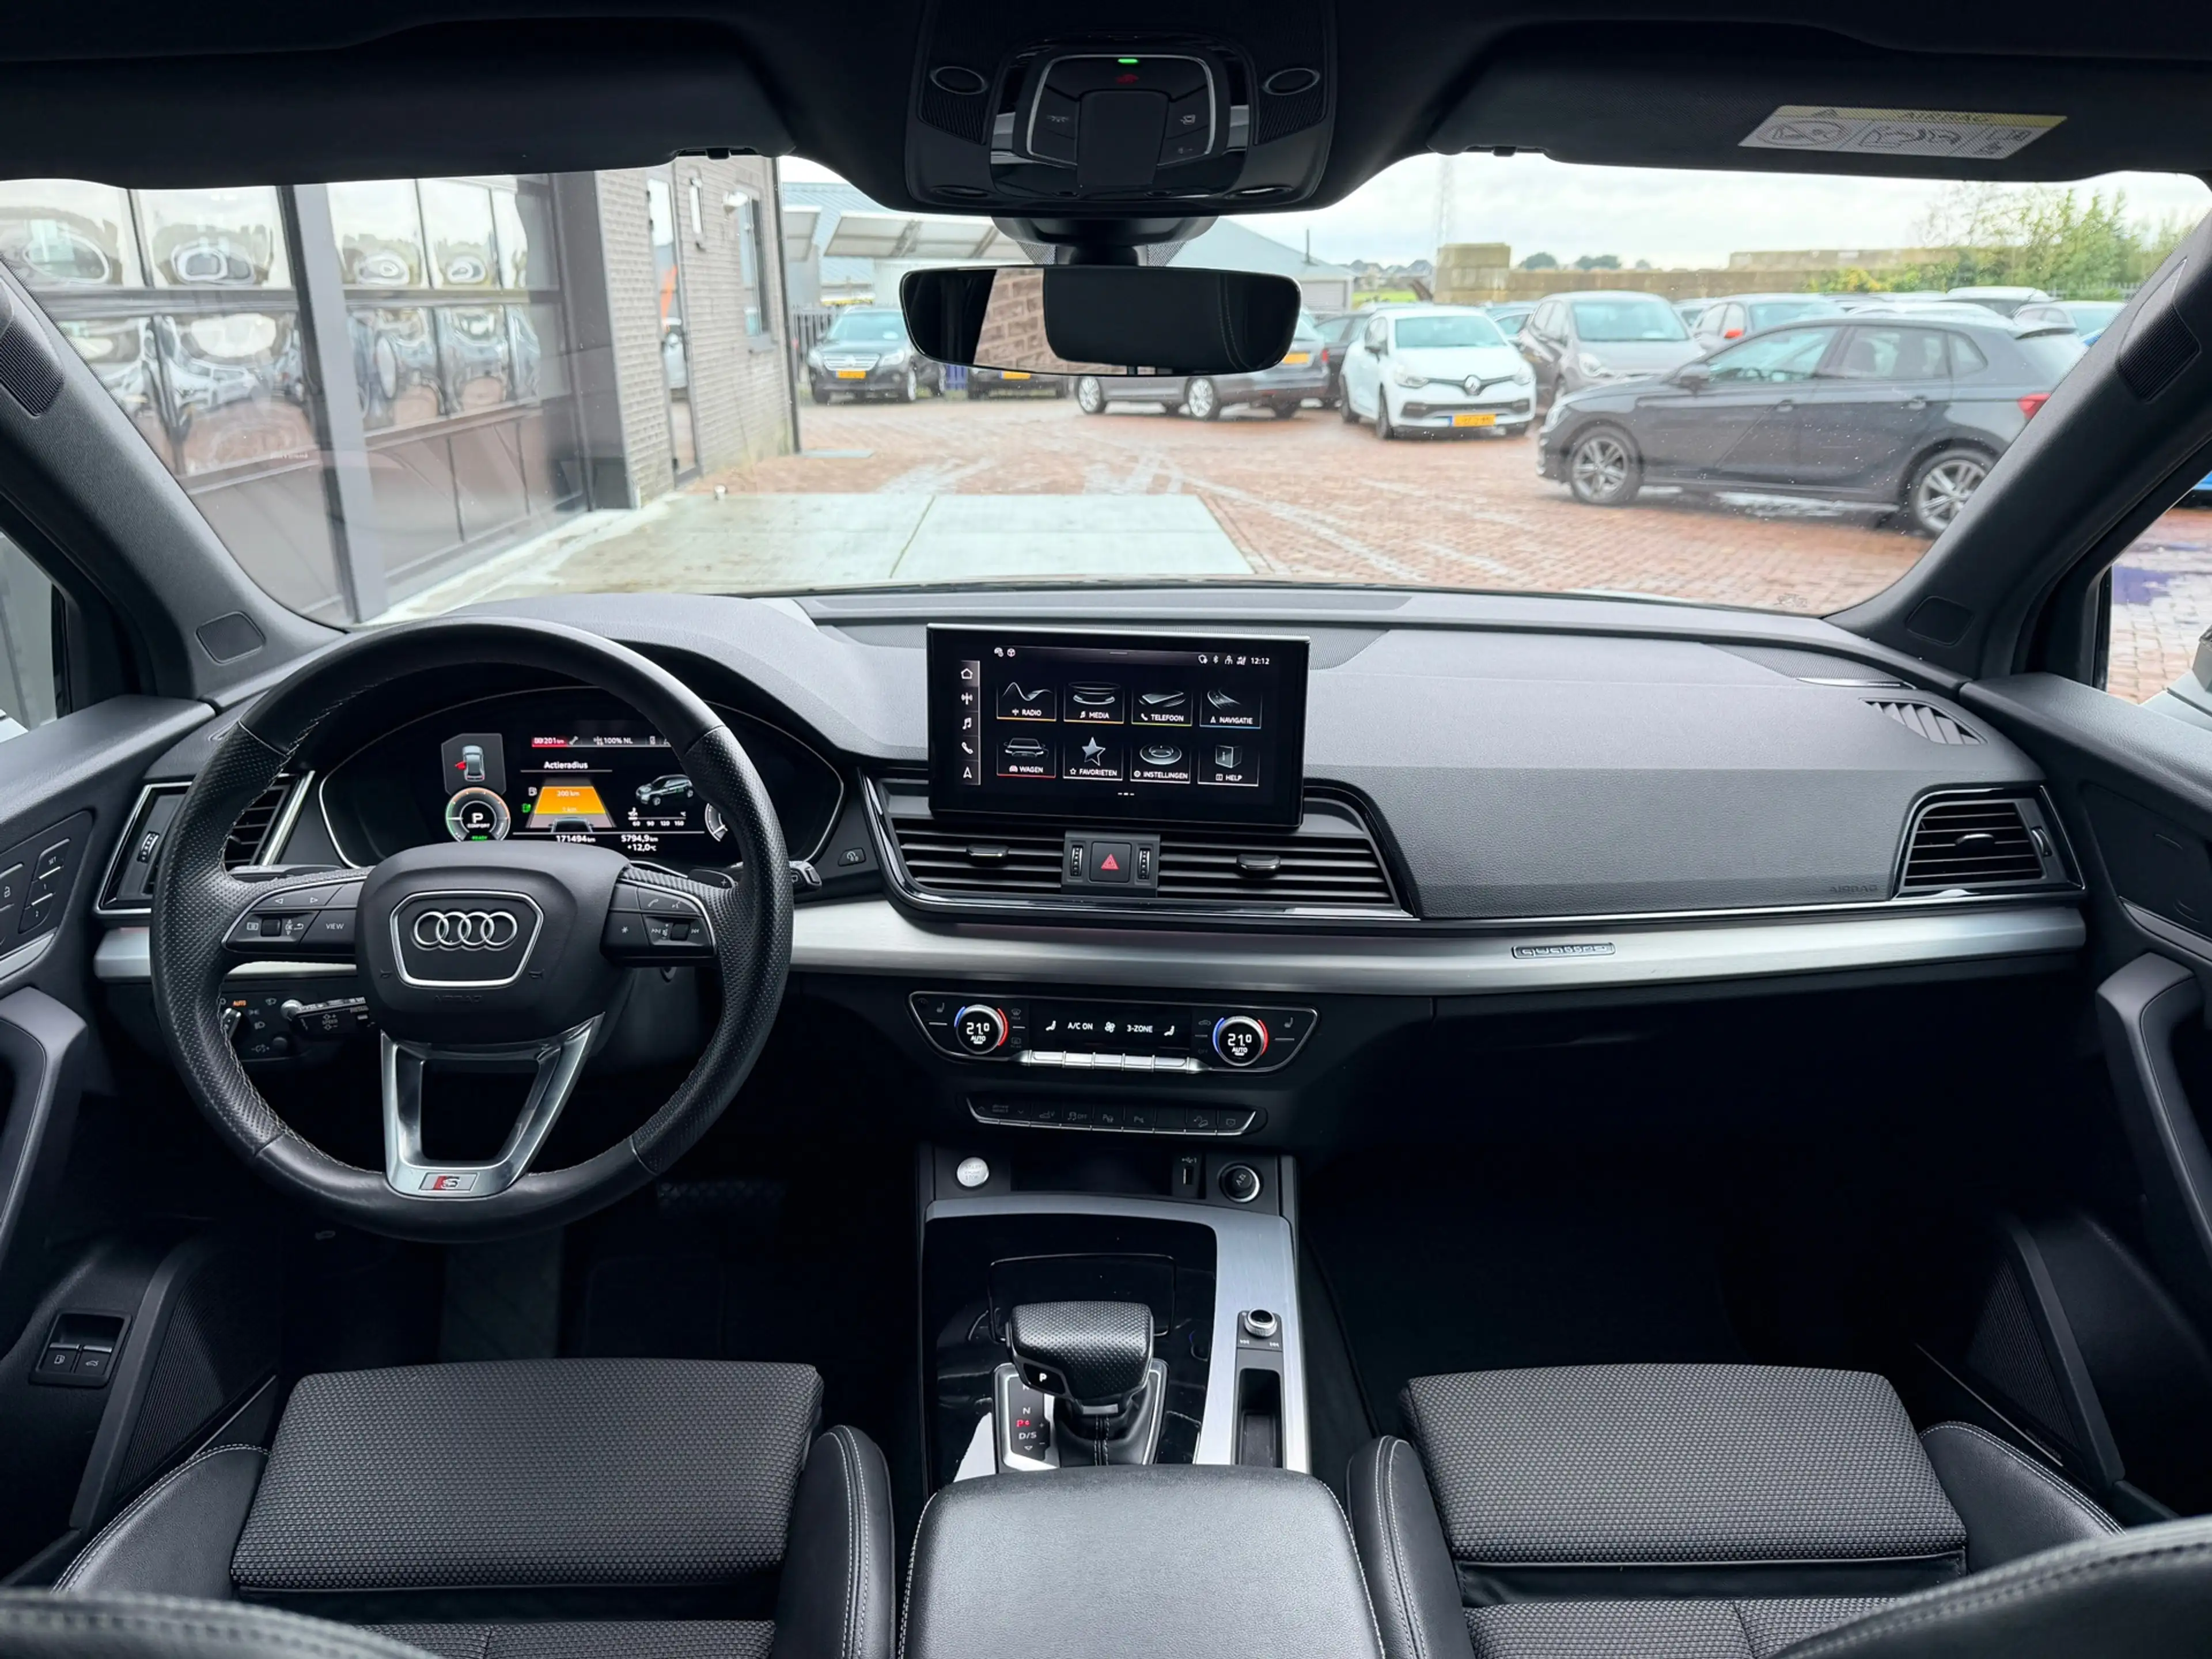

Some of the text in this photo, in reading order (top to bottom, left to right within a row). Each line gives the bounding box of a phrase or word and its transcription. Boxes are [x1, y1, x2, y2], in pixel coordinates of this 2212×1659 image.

[1151, 714, 1184, 722] TELEFOON
[1219, 716, 1253, 724] NAVIGATIE
[1079, 768, 1118, 777] FAVORIETEN
[1143, 771, 1188, 780] INSTELLINGEN
[471, 812, 484, 824] P
[1067, 1022, 1081, 1030] A/C
[1126, 1024, 1153, 1033] 3-ZONE
[1039, 1373, 1047, 1382] P
[1018, 1432, 1037, 1440] D/S
